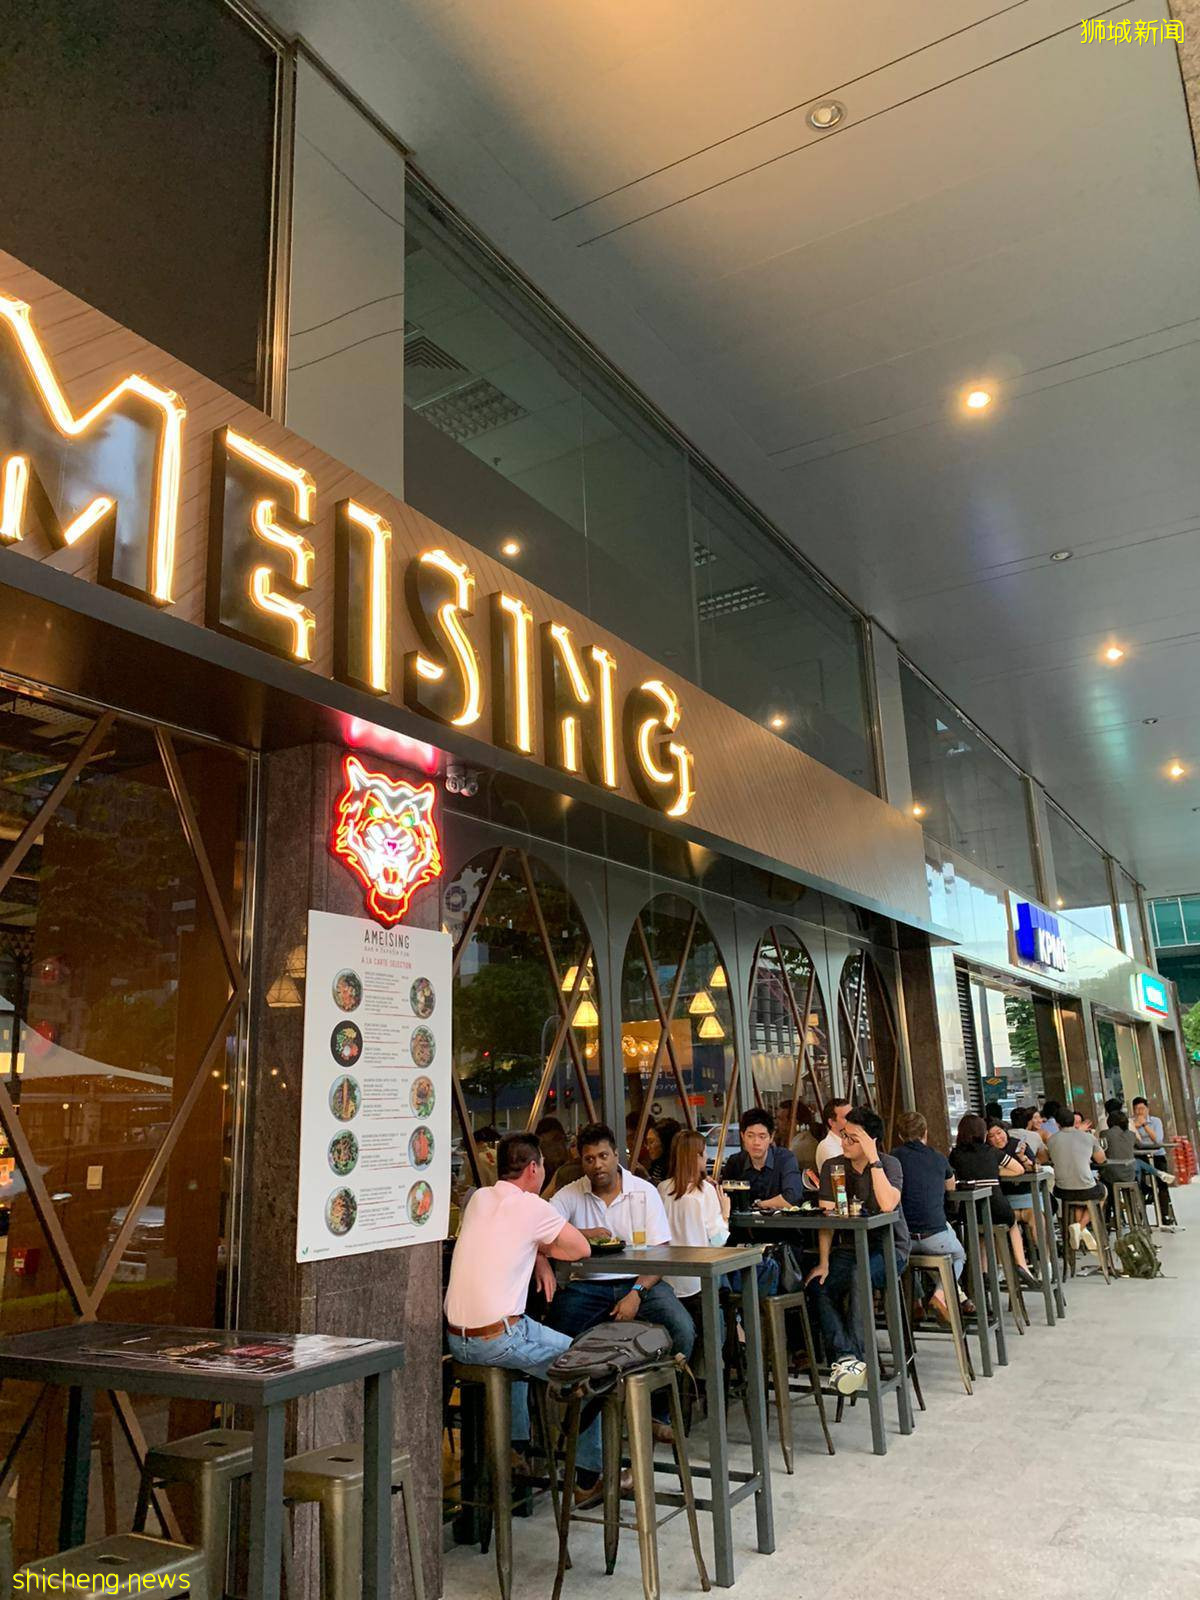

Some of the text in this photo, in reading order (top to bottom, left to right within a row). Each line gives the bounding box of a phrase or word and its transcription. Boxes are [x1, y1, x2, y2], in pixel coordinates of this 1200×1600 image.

[364, 929, 409, 949] AMEISING
[1037, 927, 1067, 972] KPMG
[389, 959, 412, 969] SELECTION
